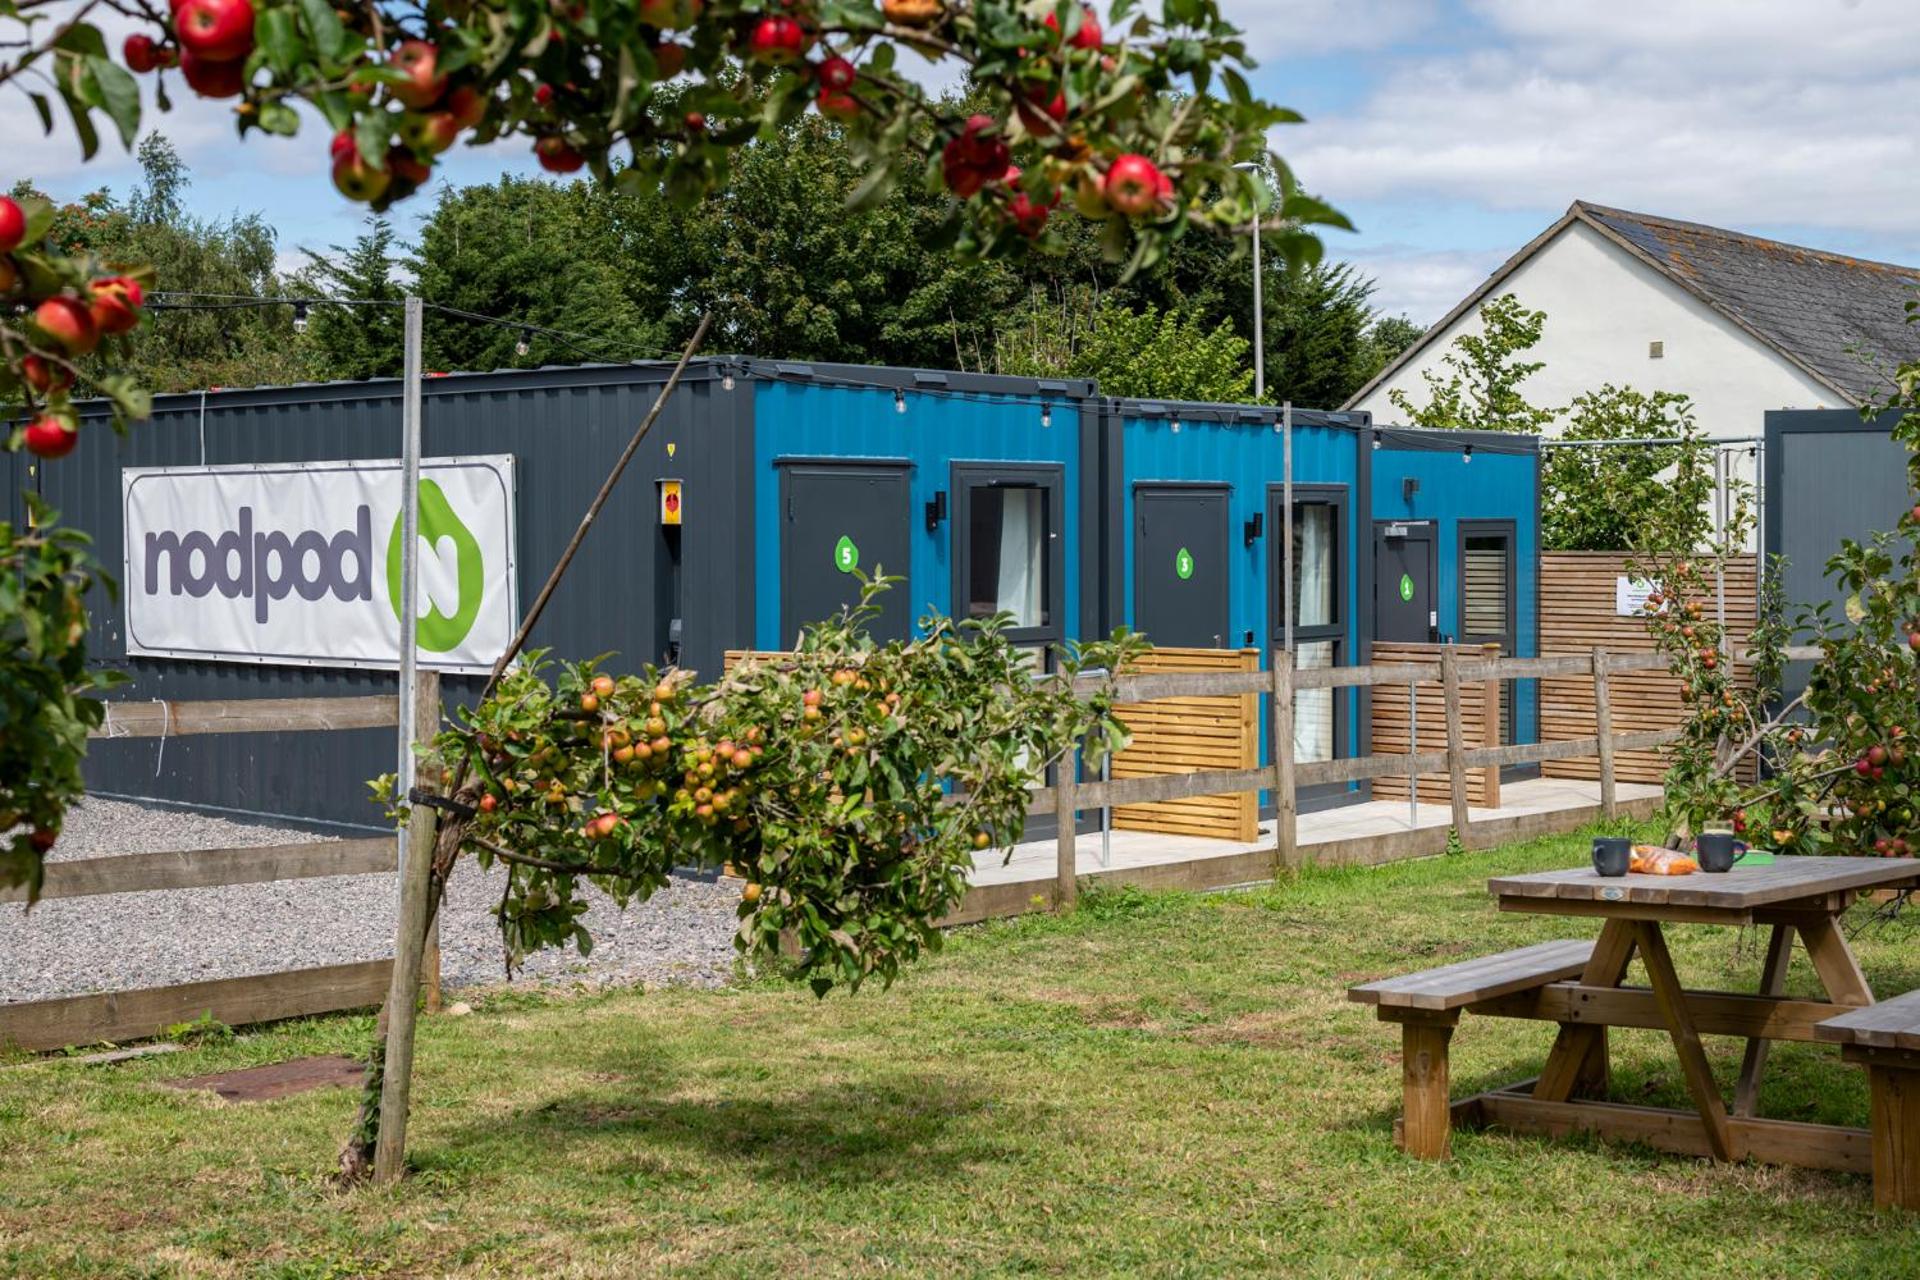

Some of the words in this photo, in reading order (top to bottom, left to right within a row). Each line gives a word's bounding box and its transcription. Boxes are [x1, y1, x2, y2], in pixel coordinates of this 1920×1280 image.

[842, 547, 852, 564] 5
[145, 505, 373, 624] nodpod
[1181, 557, 1189, 572] 3
